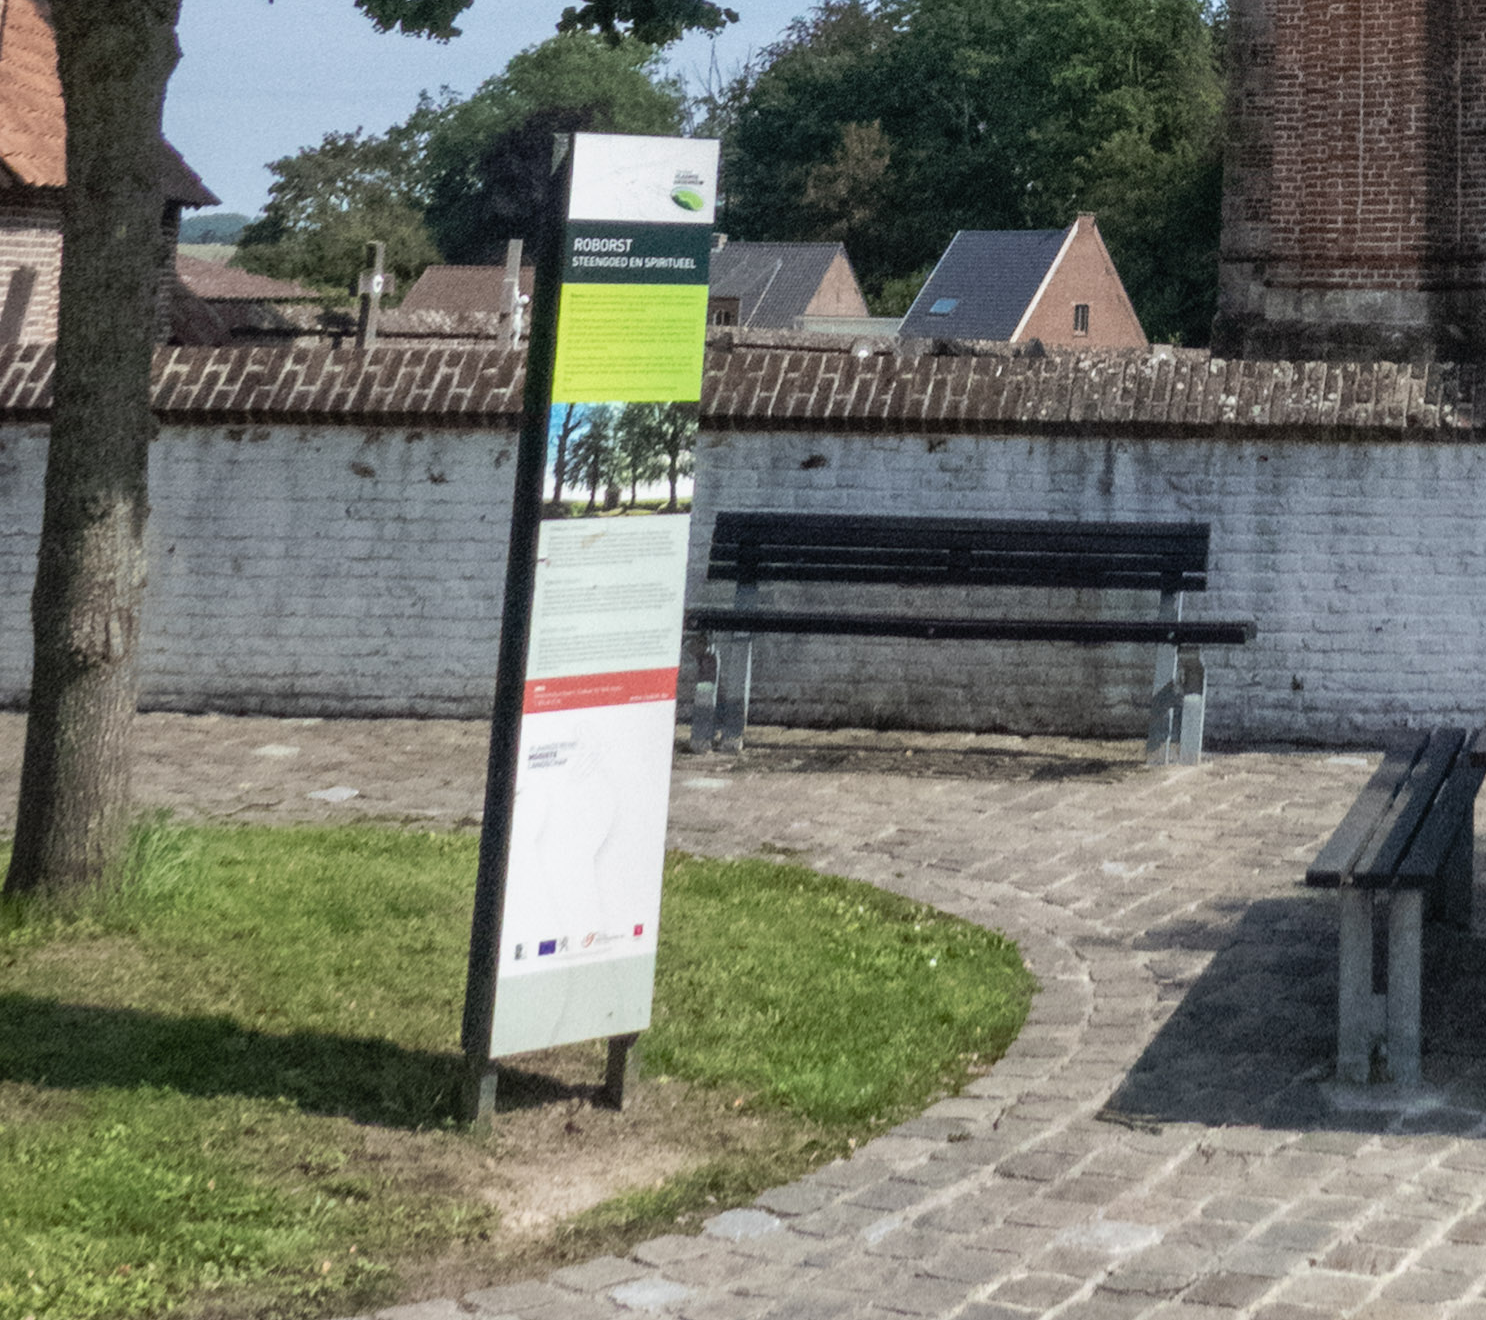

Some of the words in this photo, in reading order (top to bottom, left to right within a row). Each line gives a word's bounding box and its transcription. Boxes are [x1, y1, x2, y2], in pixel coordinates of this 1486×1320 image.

[573, 238, 633, 252] ROBORST
[572, 256, 628, 268] STEENGOED
[629, 257, 643, 268] EN
[644, 257, 697, 270] SPIRITUEEL
